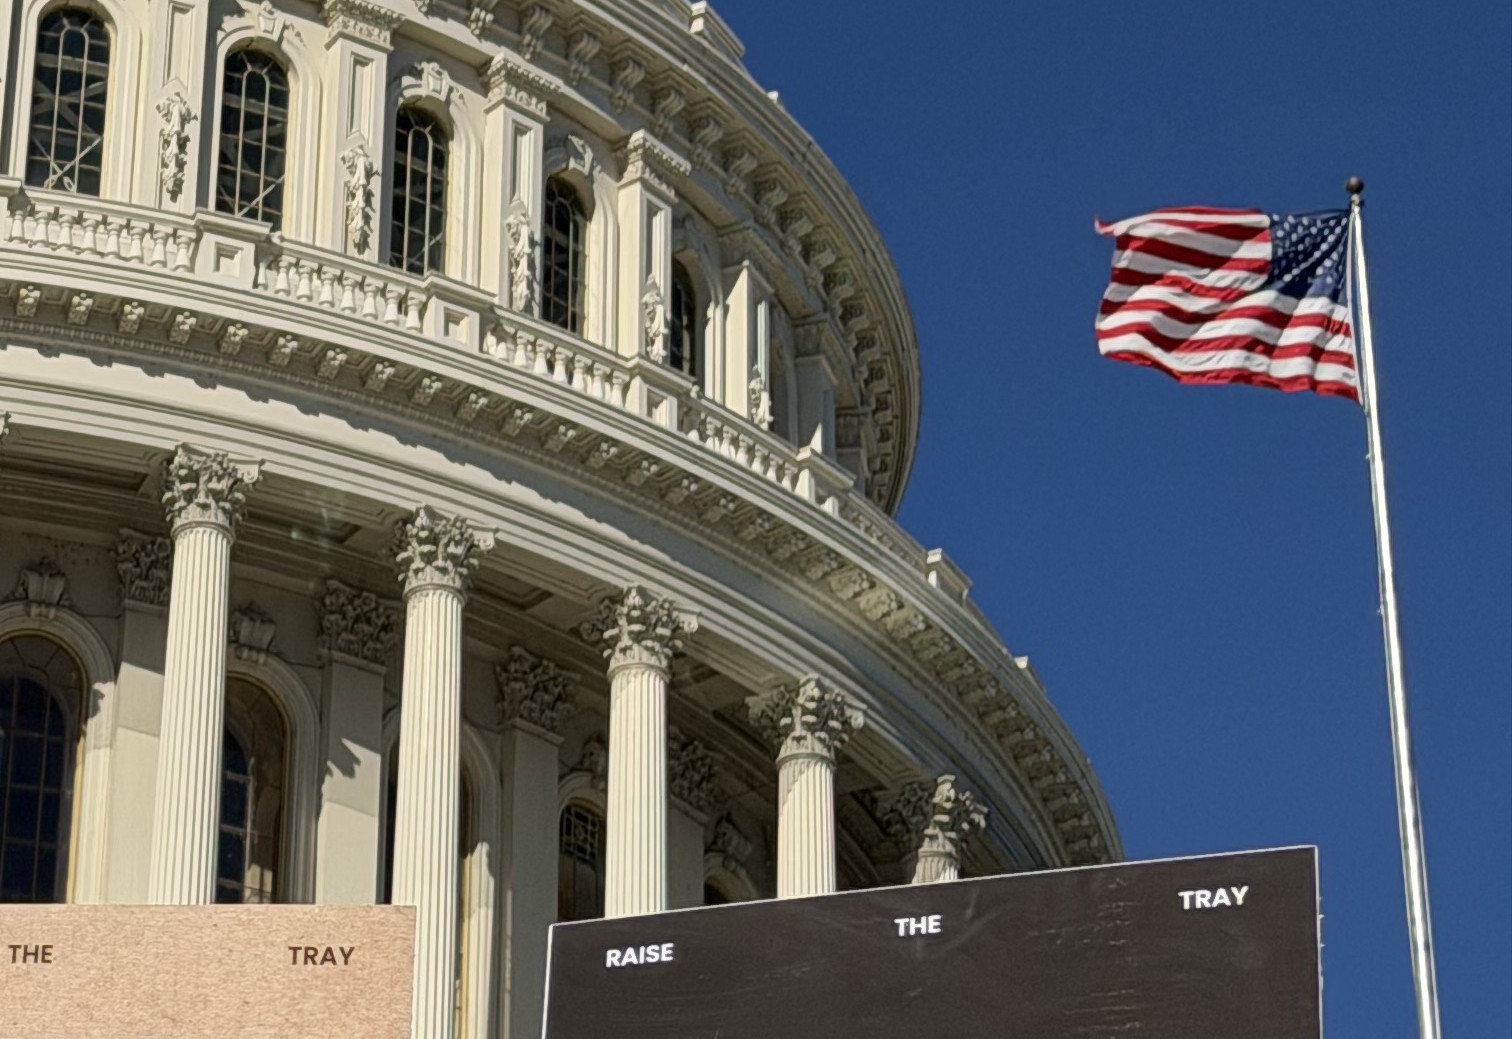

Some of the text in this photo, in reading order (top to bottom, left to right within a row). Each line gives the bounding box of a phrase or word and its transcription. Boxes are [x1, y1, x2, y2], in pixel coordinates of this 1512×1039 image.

[605, 885, 1249, 968] RAISE THE TRAY
[7, 944, 54, 964] THE
[287, 946, 355, 966] TRAY
